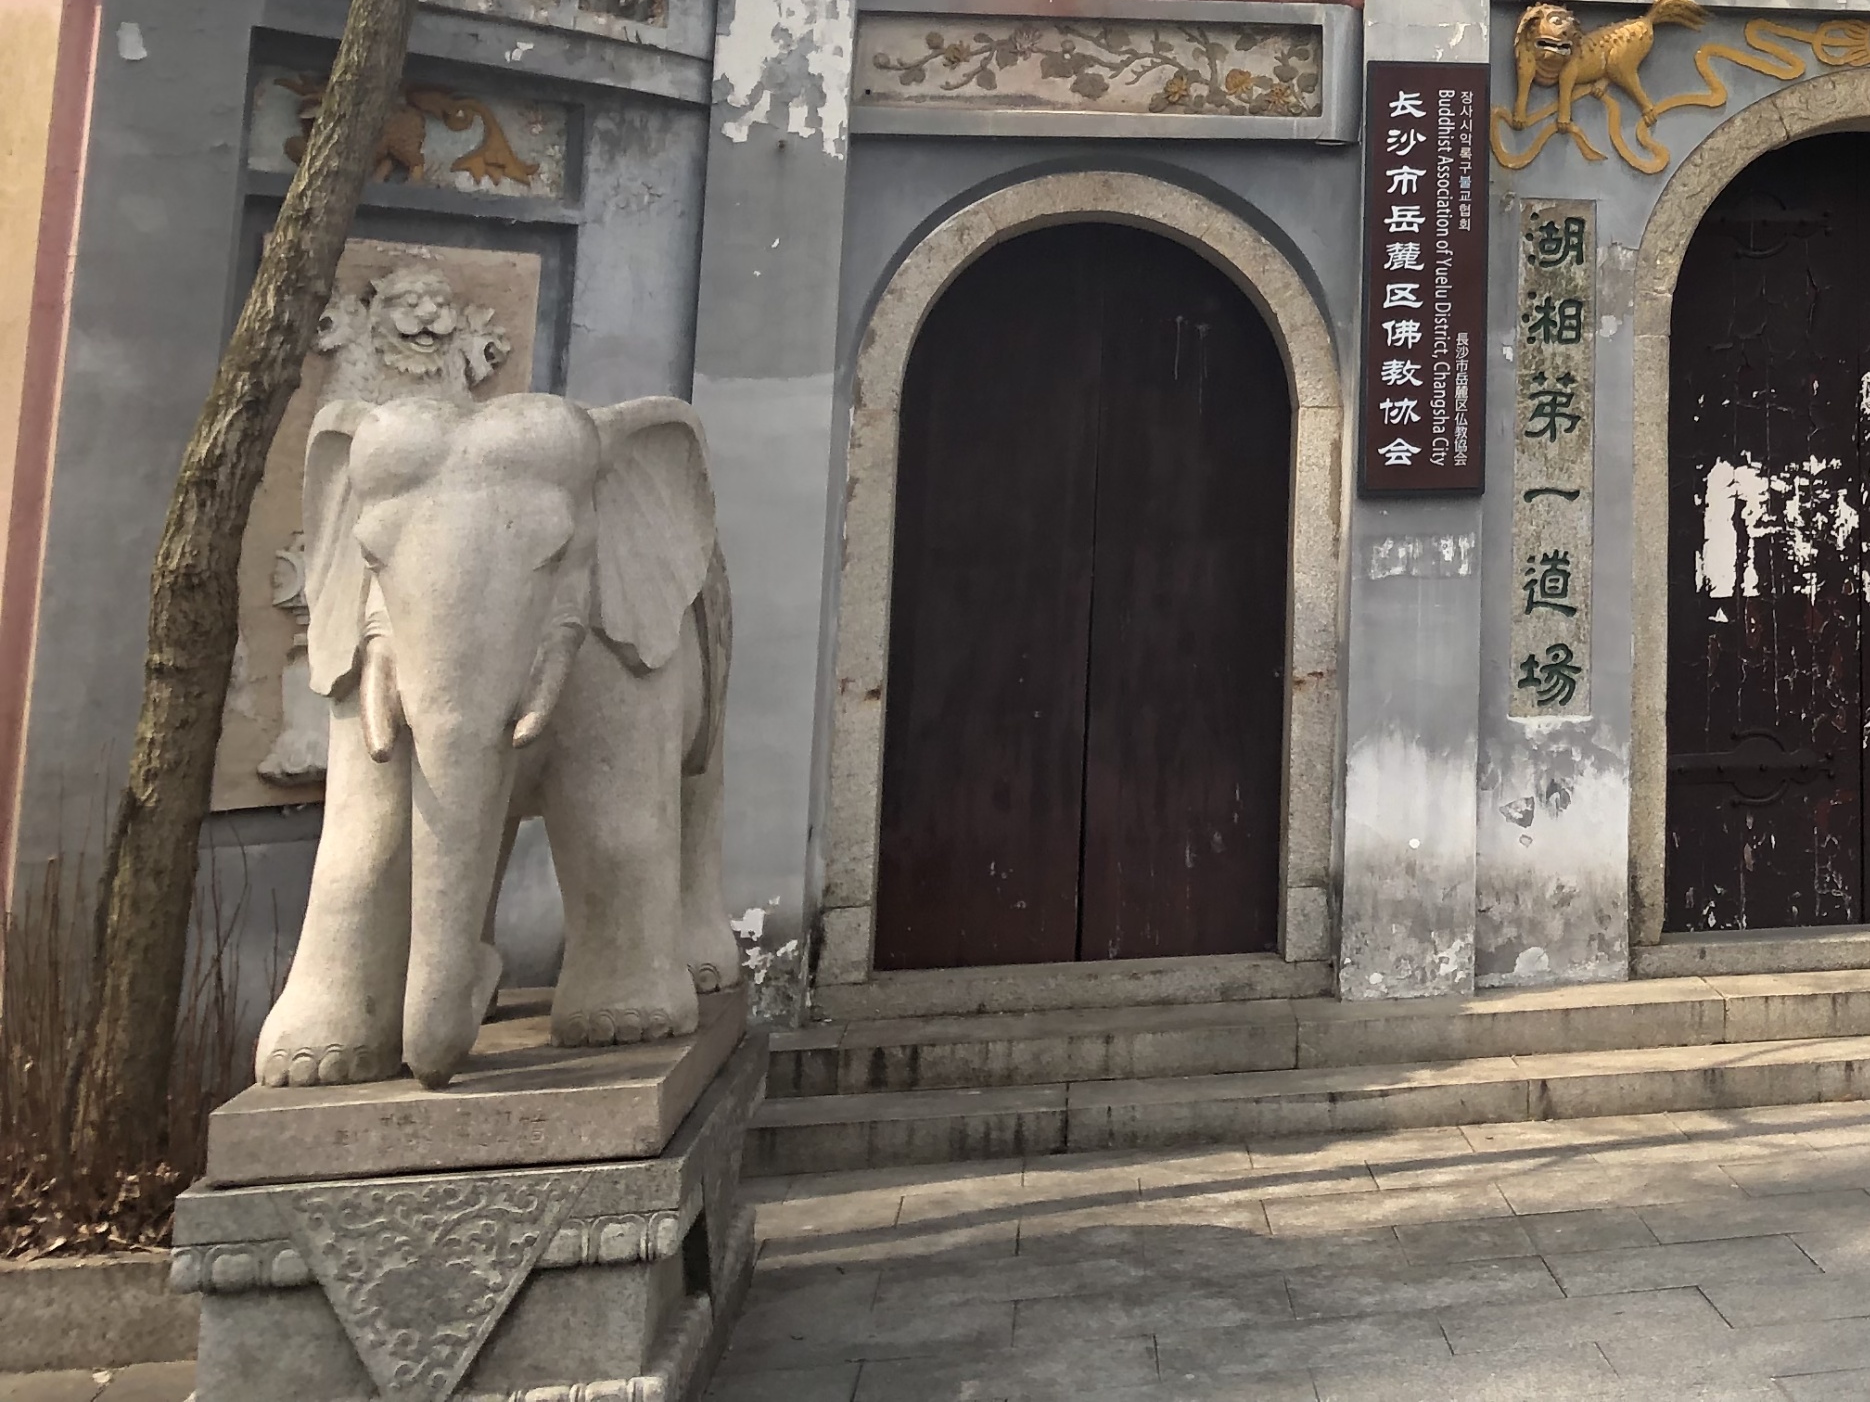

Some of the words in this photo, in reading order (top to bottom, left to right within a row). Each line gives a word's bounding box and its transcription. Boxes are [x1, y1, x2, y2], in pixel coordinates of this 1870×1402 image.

[1437, 89, 1455, 152] Buddhist
[1436, 155, 1454, 237] Association
[1436, 240, 1453, 256] of
[1377, 90, 1427, 467] 长沙市岳麓区佛教协会
[1435, 258, 1453, 298] Yuelu
[1432, 302, 1452, 358] District,
[1430, 362, 1451, 434] Changsha
[1430, 437, 1450, 466] City
